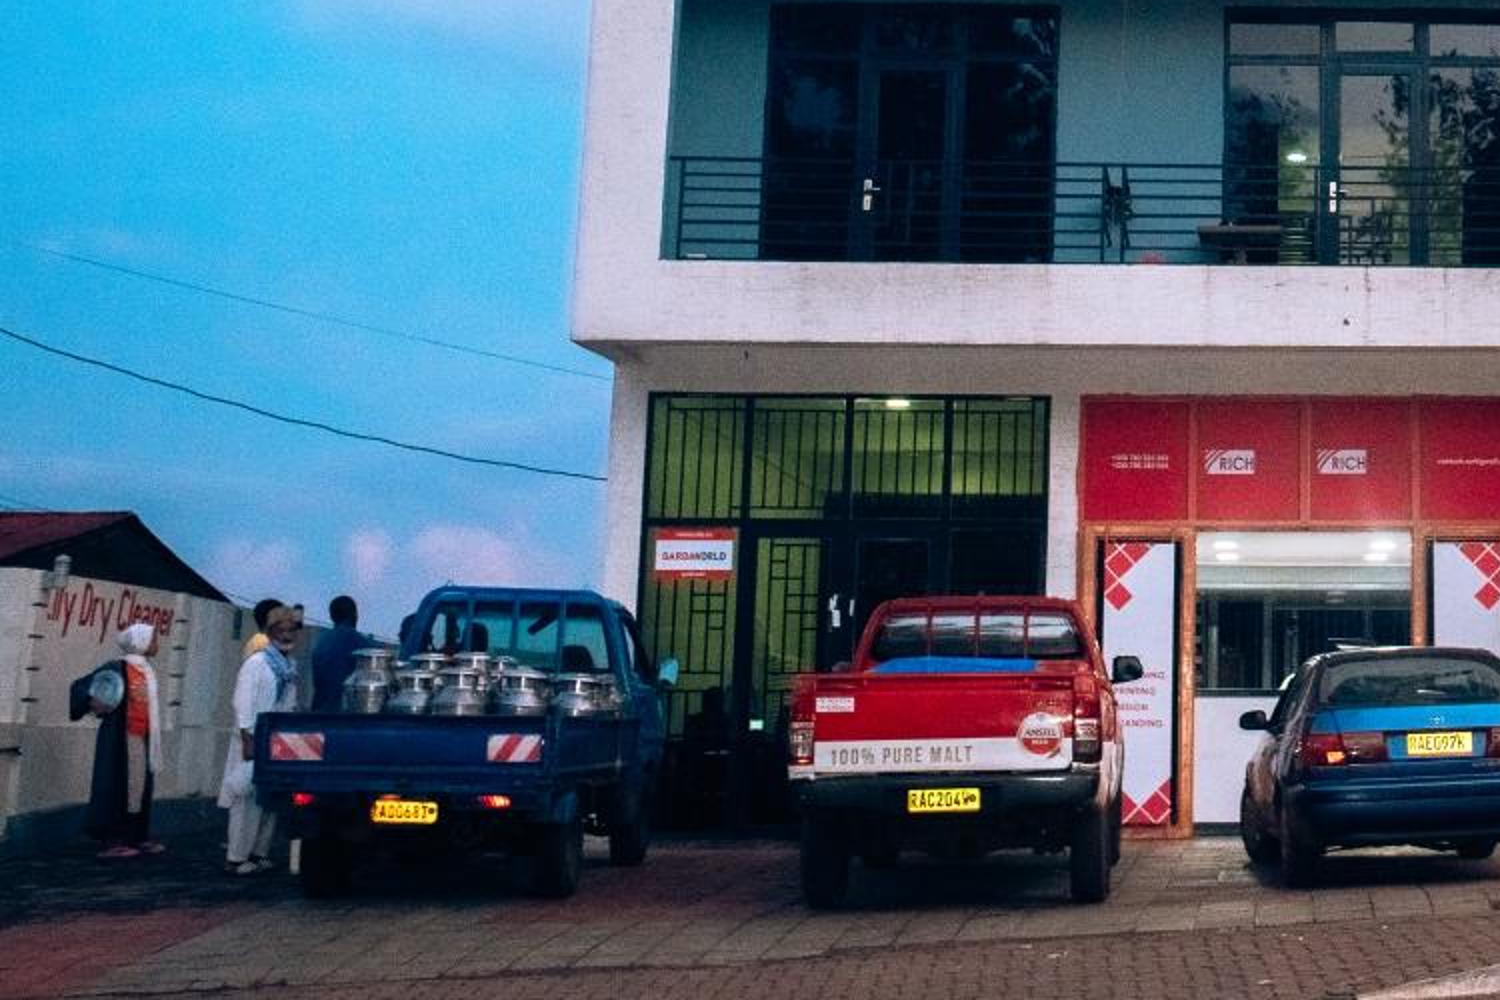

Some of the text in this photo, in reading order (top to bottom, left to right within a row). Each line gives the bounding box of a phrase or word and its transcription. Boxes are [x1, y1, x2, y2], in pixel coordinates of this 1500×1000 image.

[1219, 457, 1254, 471] RICH
[1331, 457, 1365, 471] RICH
[79, 582, 114, 644] Dry
[831, 745, 973, 766] 100% PURE MALT
